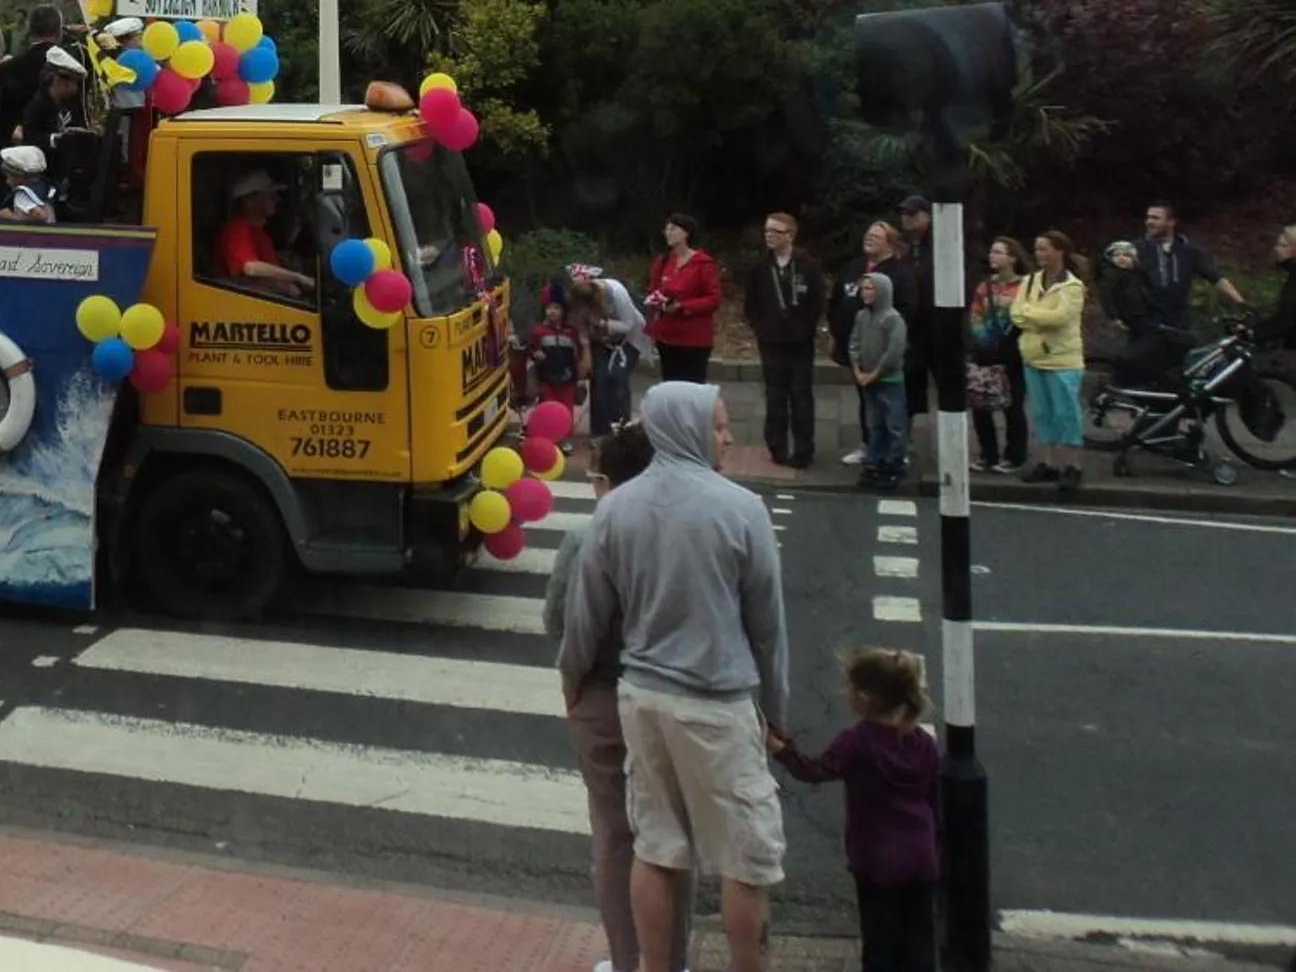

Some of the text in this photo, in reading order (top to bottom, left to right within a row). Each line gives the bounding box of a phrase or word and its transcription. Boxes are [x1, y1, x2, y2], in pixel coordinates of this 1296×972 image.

[190, 322, 312, 348] MARTELLO
[426, 330, 436, 344] 7
[188, 352, 313, 367] PLANT & TOOL HIRE
[277, 409, 387, 424] EASTBOURNE
[309, 423, 355, 437] 01323
[289, 436, 372, 459] 761887
